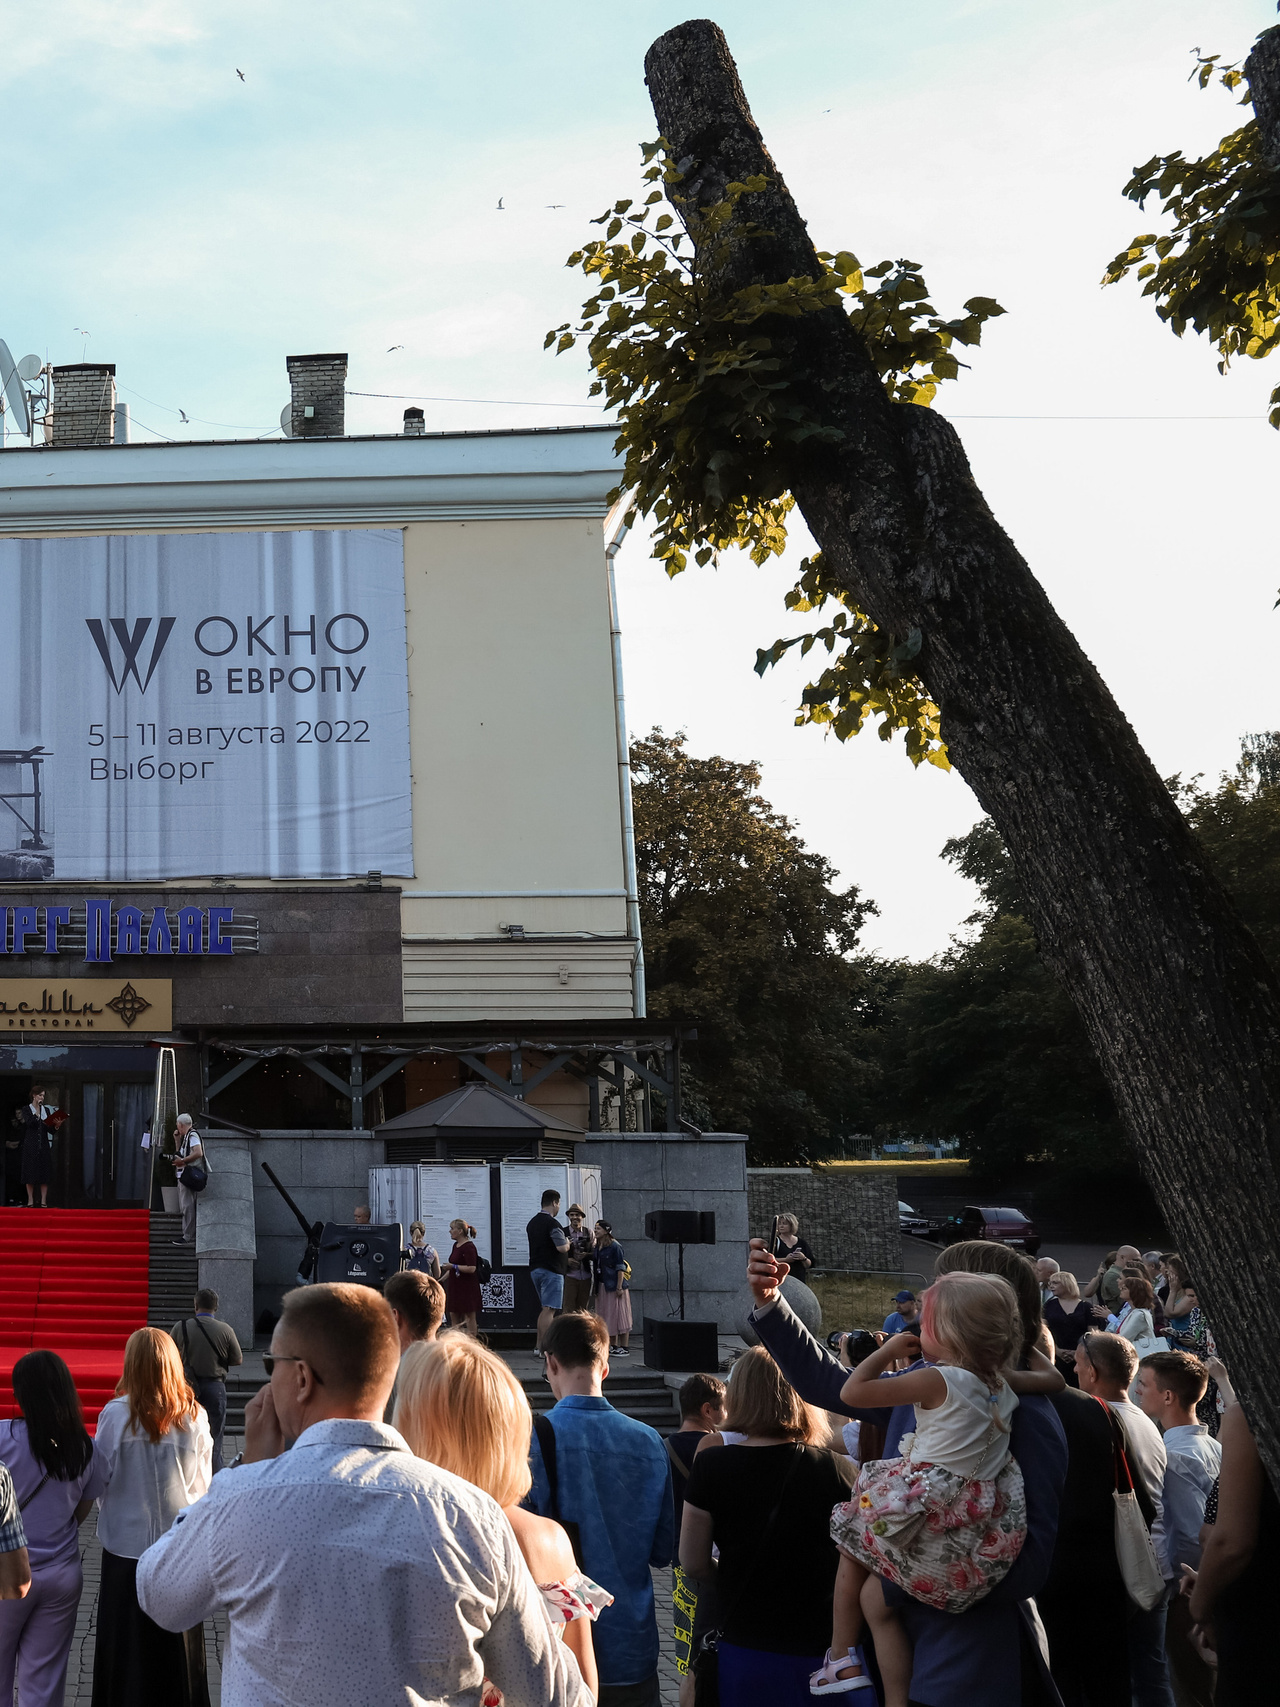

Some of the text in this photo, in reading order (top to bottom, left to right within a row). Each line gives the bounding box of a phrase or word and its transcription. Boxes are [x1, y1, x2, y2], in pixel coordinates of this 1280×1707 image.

[194, 613, 369, 656] ОКНО
[196, 666, 367, 695] В ЕВРОПУ
[88, 724, 105, 747] 5
[136, 723, 156, 745] 11
[167, 726, 286, 750] августа
[295, 720, 370, 744] 2022
[90, 755, 215, 785] Выборг
[8, 1018, 94, 1028] РЕСТОРАН
